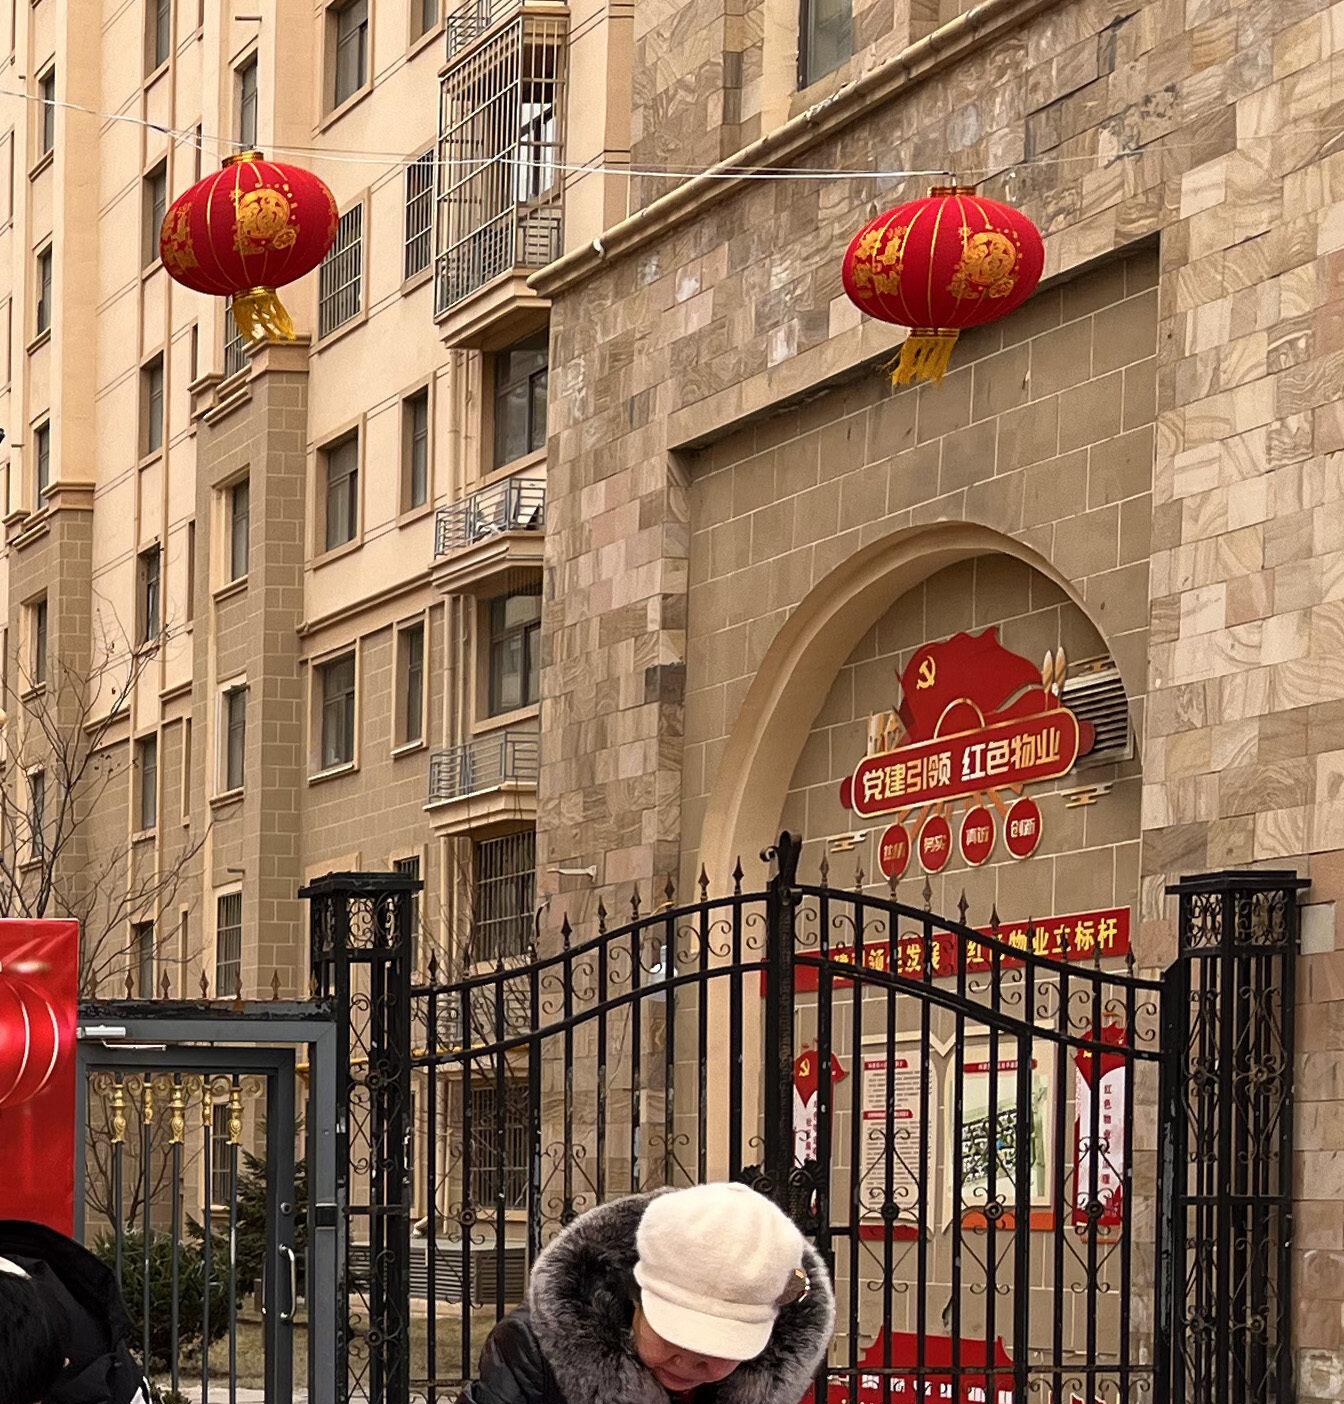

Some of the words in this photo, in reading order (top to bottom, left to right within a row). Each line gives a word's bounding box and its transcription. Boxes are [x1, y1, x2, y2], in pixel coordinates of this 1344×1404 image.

[862, 751, 952, 804] 党建引领
[961, 726, 1061, 782] 红色物业
[967, 917, 1118, 966] 红物业立标杆
